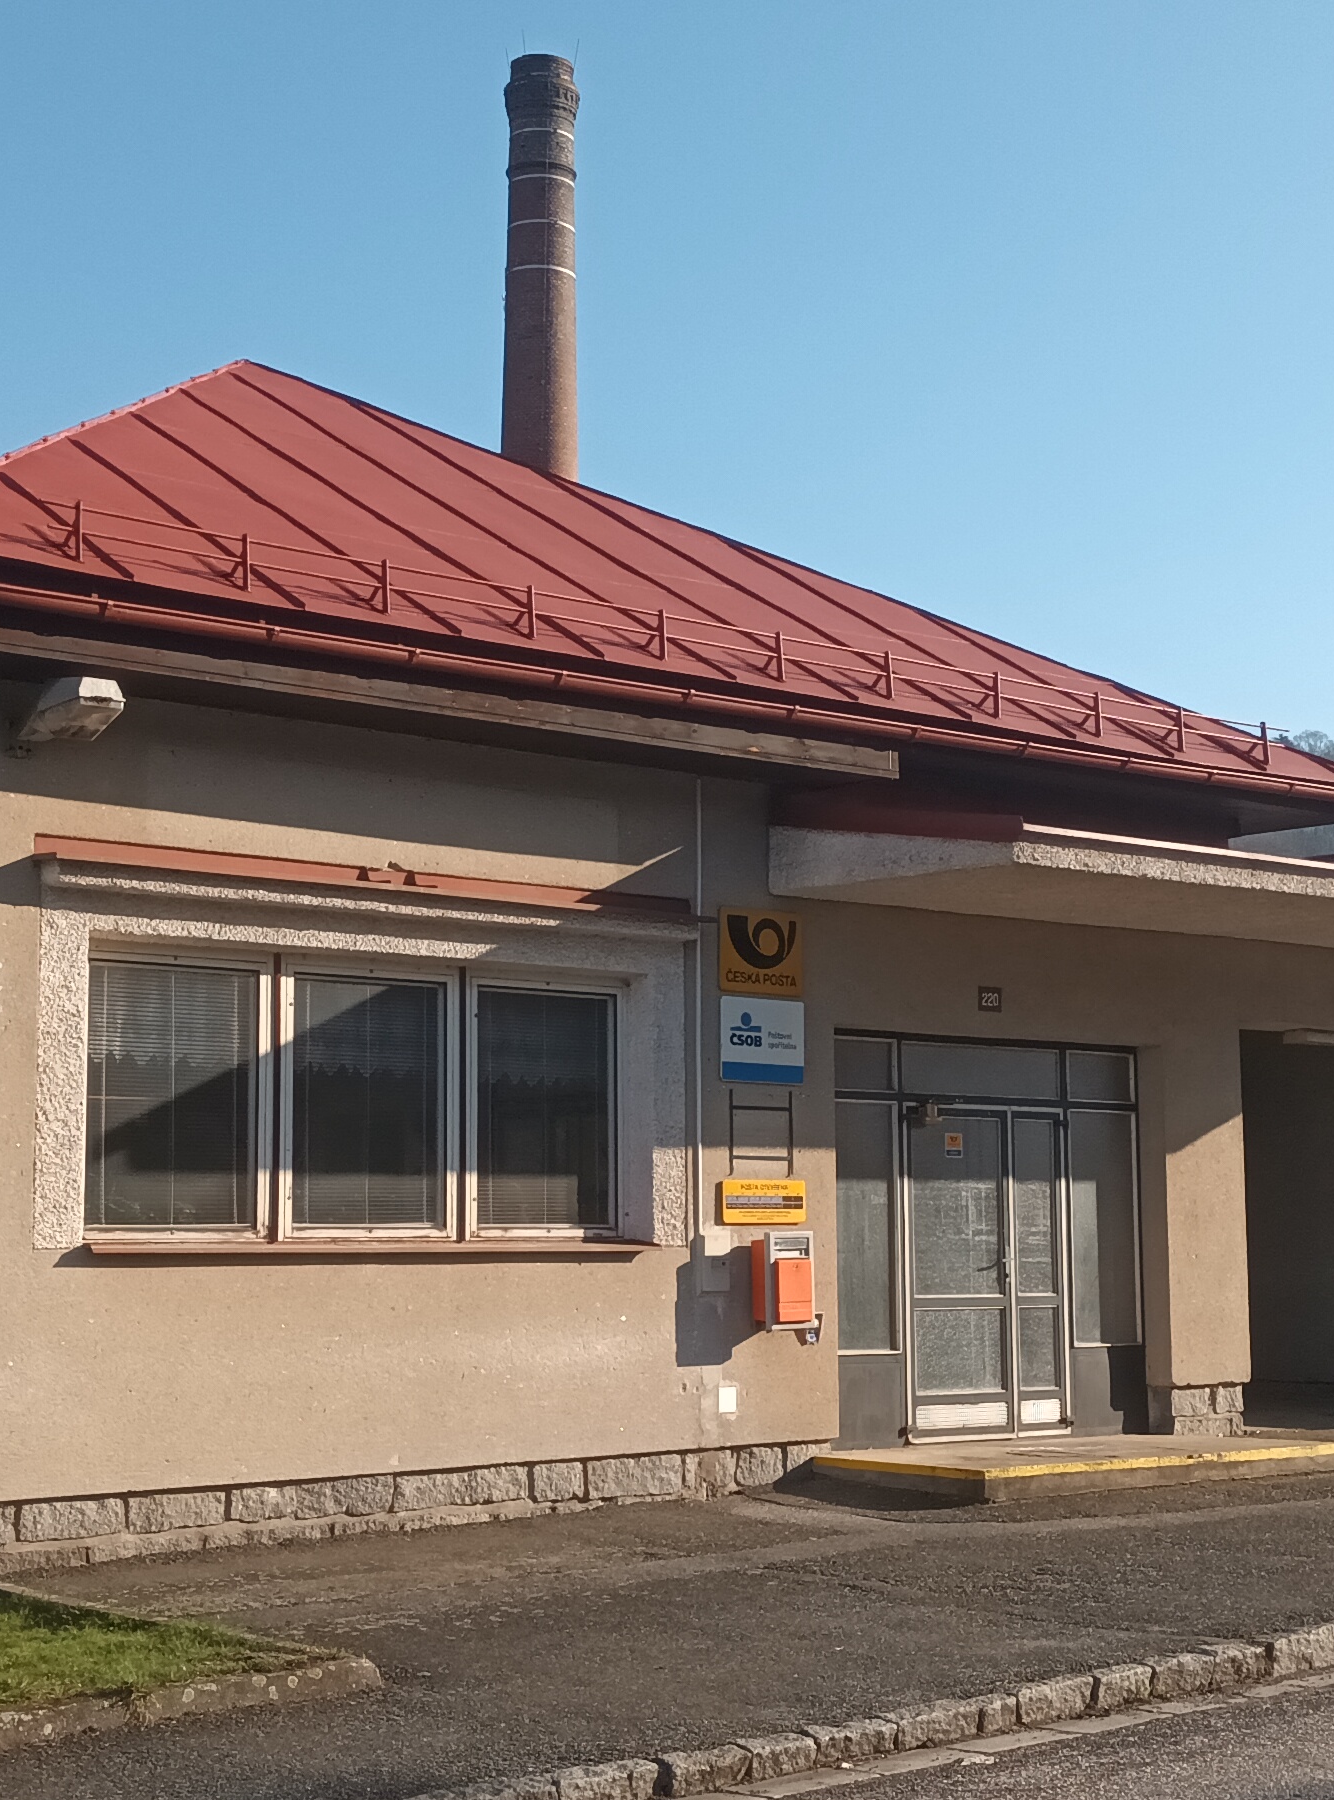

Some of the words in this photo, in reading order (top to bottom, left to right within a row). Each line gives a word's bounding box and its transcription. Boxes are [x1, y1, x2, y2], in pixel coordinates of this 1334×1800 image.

[725, 968, 761, 985] ČESKÁ
[762, 972, 797, 988] POŠTA
[981, 992, 999, 1007] 220
[729, 1032, 763, 1048] ČSOB
